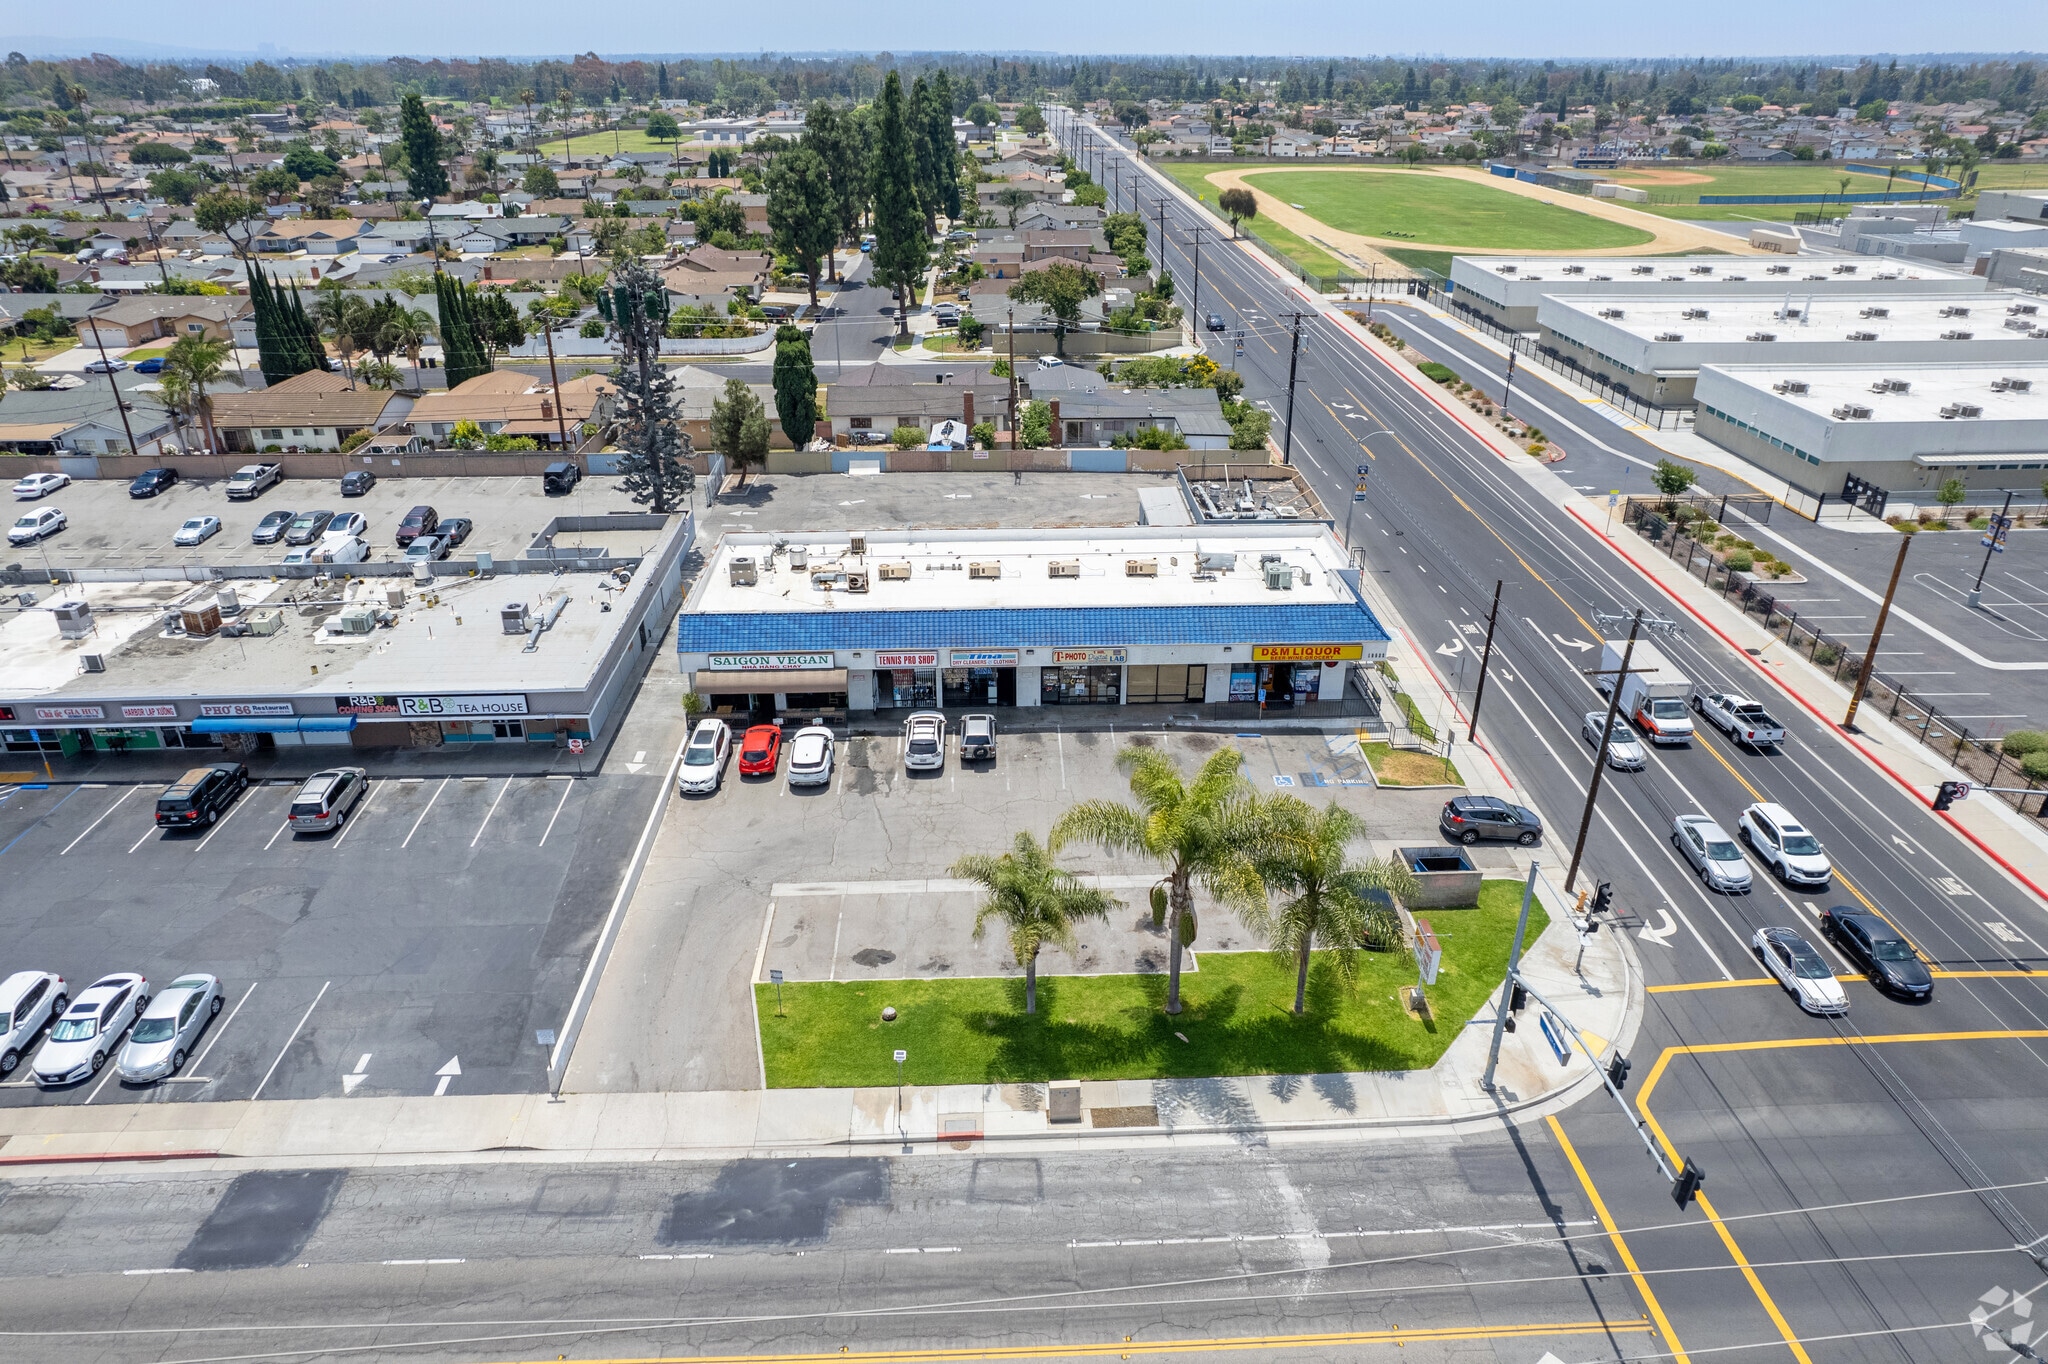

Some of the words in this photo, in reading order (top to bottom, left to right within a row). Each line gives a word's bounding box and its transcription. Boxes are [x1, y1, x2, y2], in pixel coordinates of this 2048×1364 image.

[1261, 647, 1290, 656] D&M
[1293, 647, 1341, 656] LIQUOR
[713, 656, 770, 666] SAIGON
[776, 655, 829, 665] VEGAN
[879, 655, 902, 665] TENNIS
[903, 655, 916, 665] PRO
[918, 655, 935, 665] SHOP
[349, 695, 377, 706] R&B
[234, 704, 252, 715] 86
[338, 705, 374, 714] COMING
[375, 704, 399, 713] SOON
[402, 698, 444, 714] R&B
[457, 704, 479, 713] TEA
[482, 703, 524, 712] HOUSE
[124, 707, 145, 717] HARBOR
